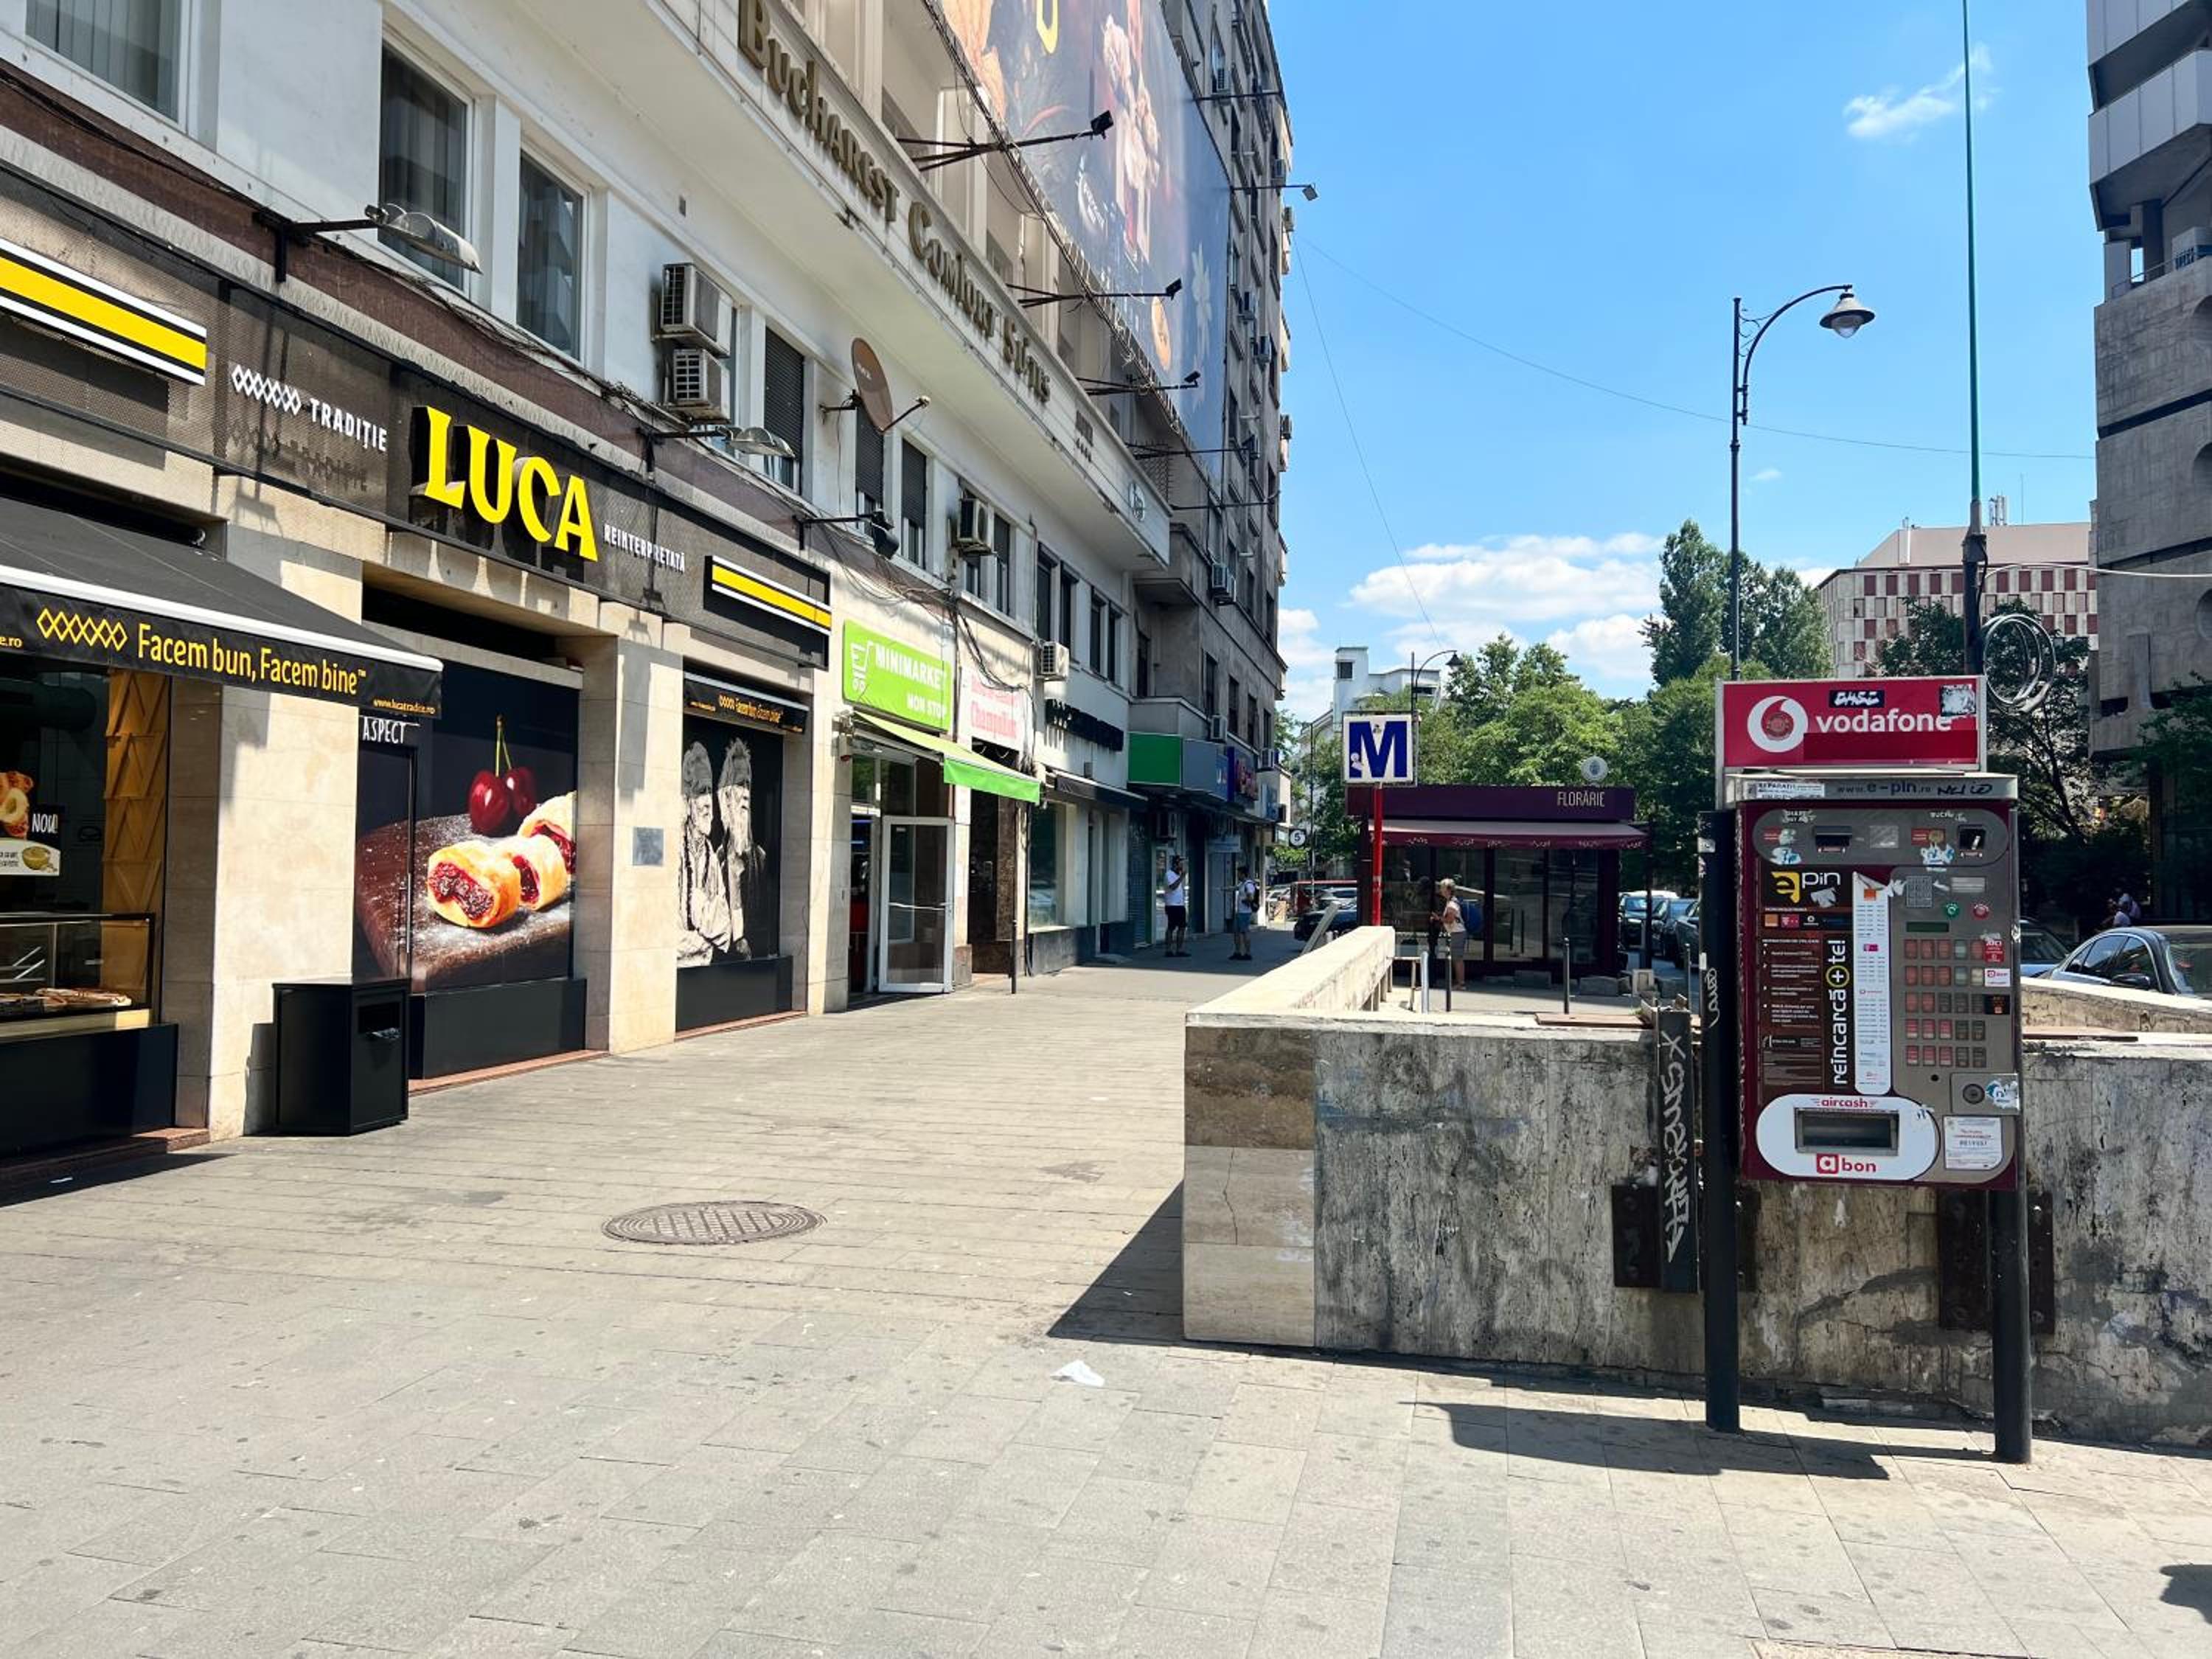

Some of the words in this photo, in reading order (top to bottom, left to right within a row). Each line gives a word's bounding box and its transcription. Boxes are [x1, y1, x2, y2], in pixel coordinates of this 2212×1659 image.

[422, 405, 598, 561] LUCA
[138, 623, 208, 669] Facem
[213, 639, 256, 683] bun,
[260, 647, 318, 689] Facem
[1349, 720, 1408, 778] M
[1816, 709, 1952, 732] vodafone
[1821, 1098, 1868, 1107] aircash
